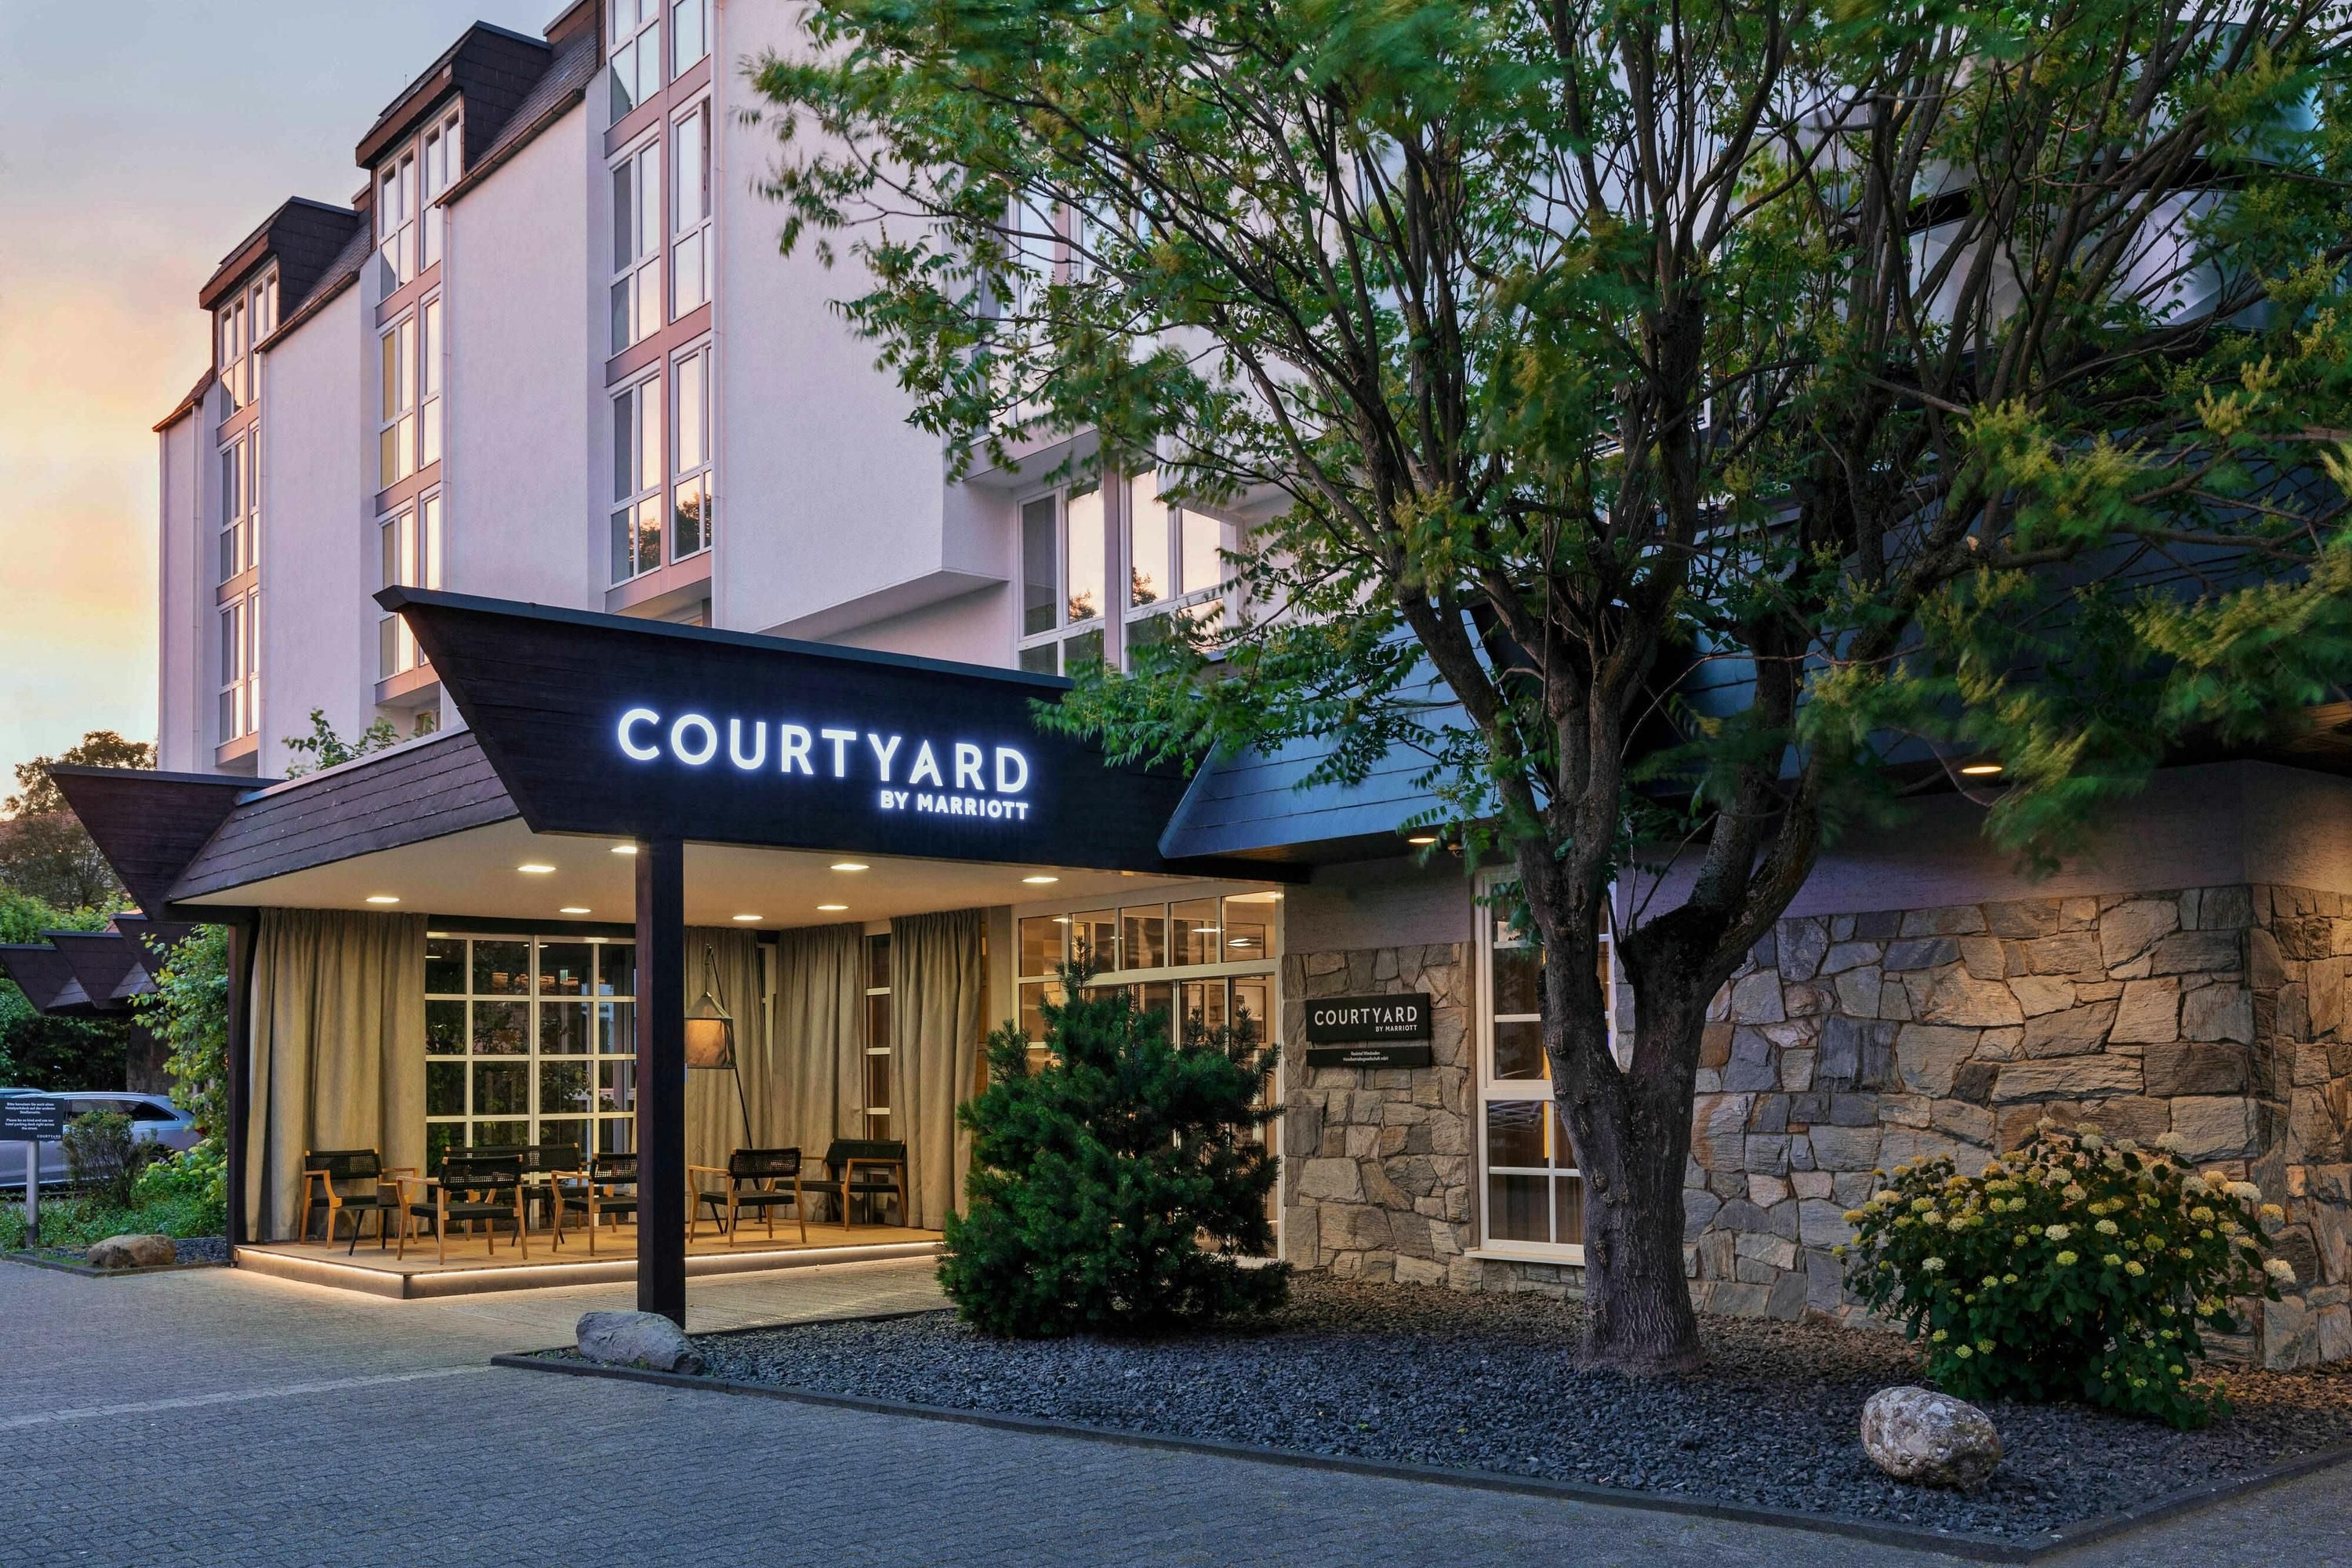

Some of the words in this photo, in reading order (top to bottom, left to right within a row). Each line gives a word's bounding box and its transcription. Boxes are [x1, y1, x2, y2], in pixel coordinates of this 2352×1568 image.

[618, 708, 1029, 793] COURTYARD
[880, 789, 910, 810] BY
[917, 793, 1029, 820] MARRIOTT
[1314, 1006, 1417, 1026] COURTYARD
